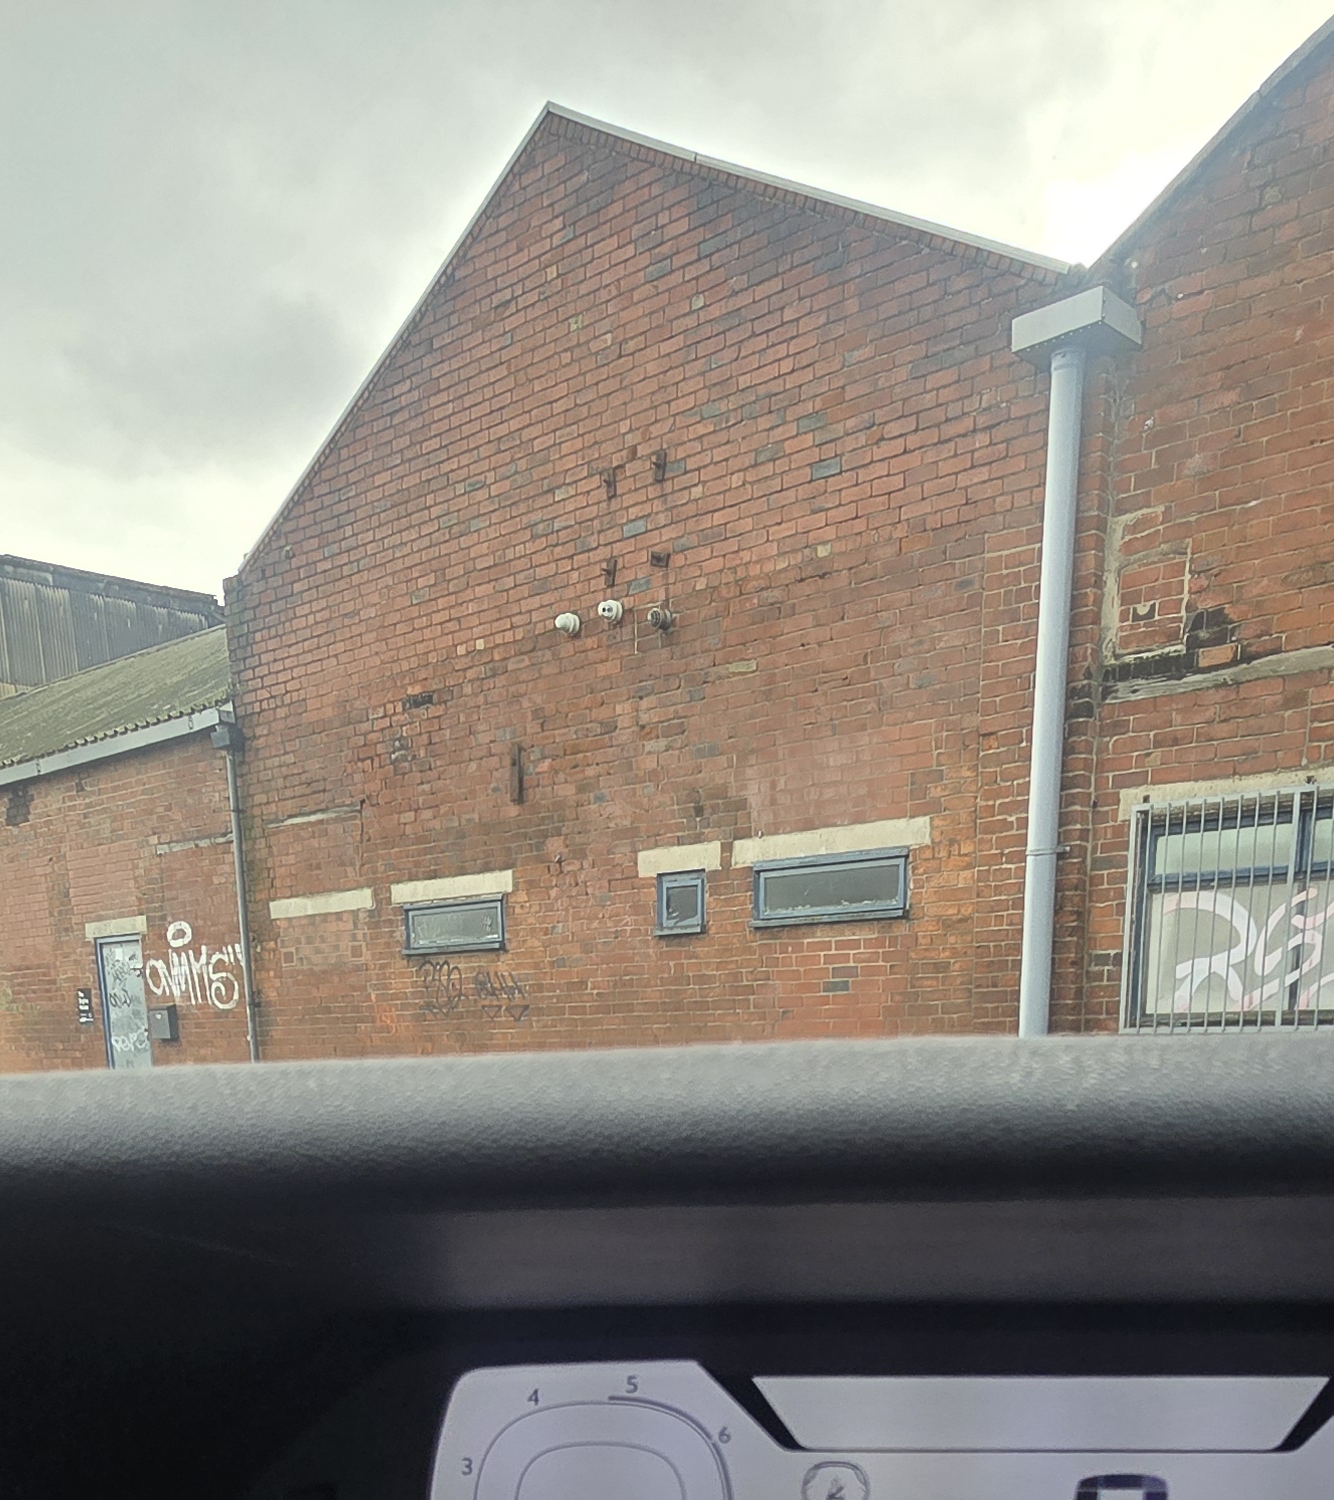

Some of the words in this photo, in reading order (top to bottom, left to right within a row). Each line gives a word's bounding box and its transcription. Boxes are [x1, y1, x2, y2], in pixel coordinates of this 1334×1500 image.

[626, 1375, 639, 1394] 5
[527, 1388, 539, 1406] 4
[717, 1427, 731, 1444] 6
[460, 1458, 473, 1476] 3
